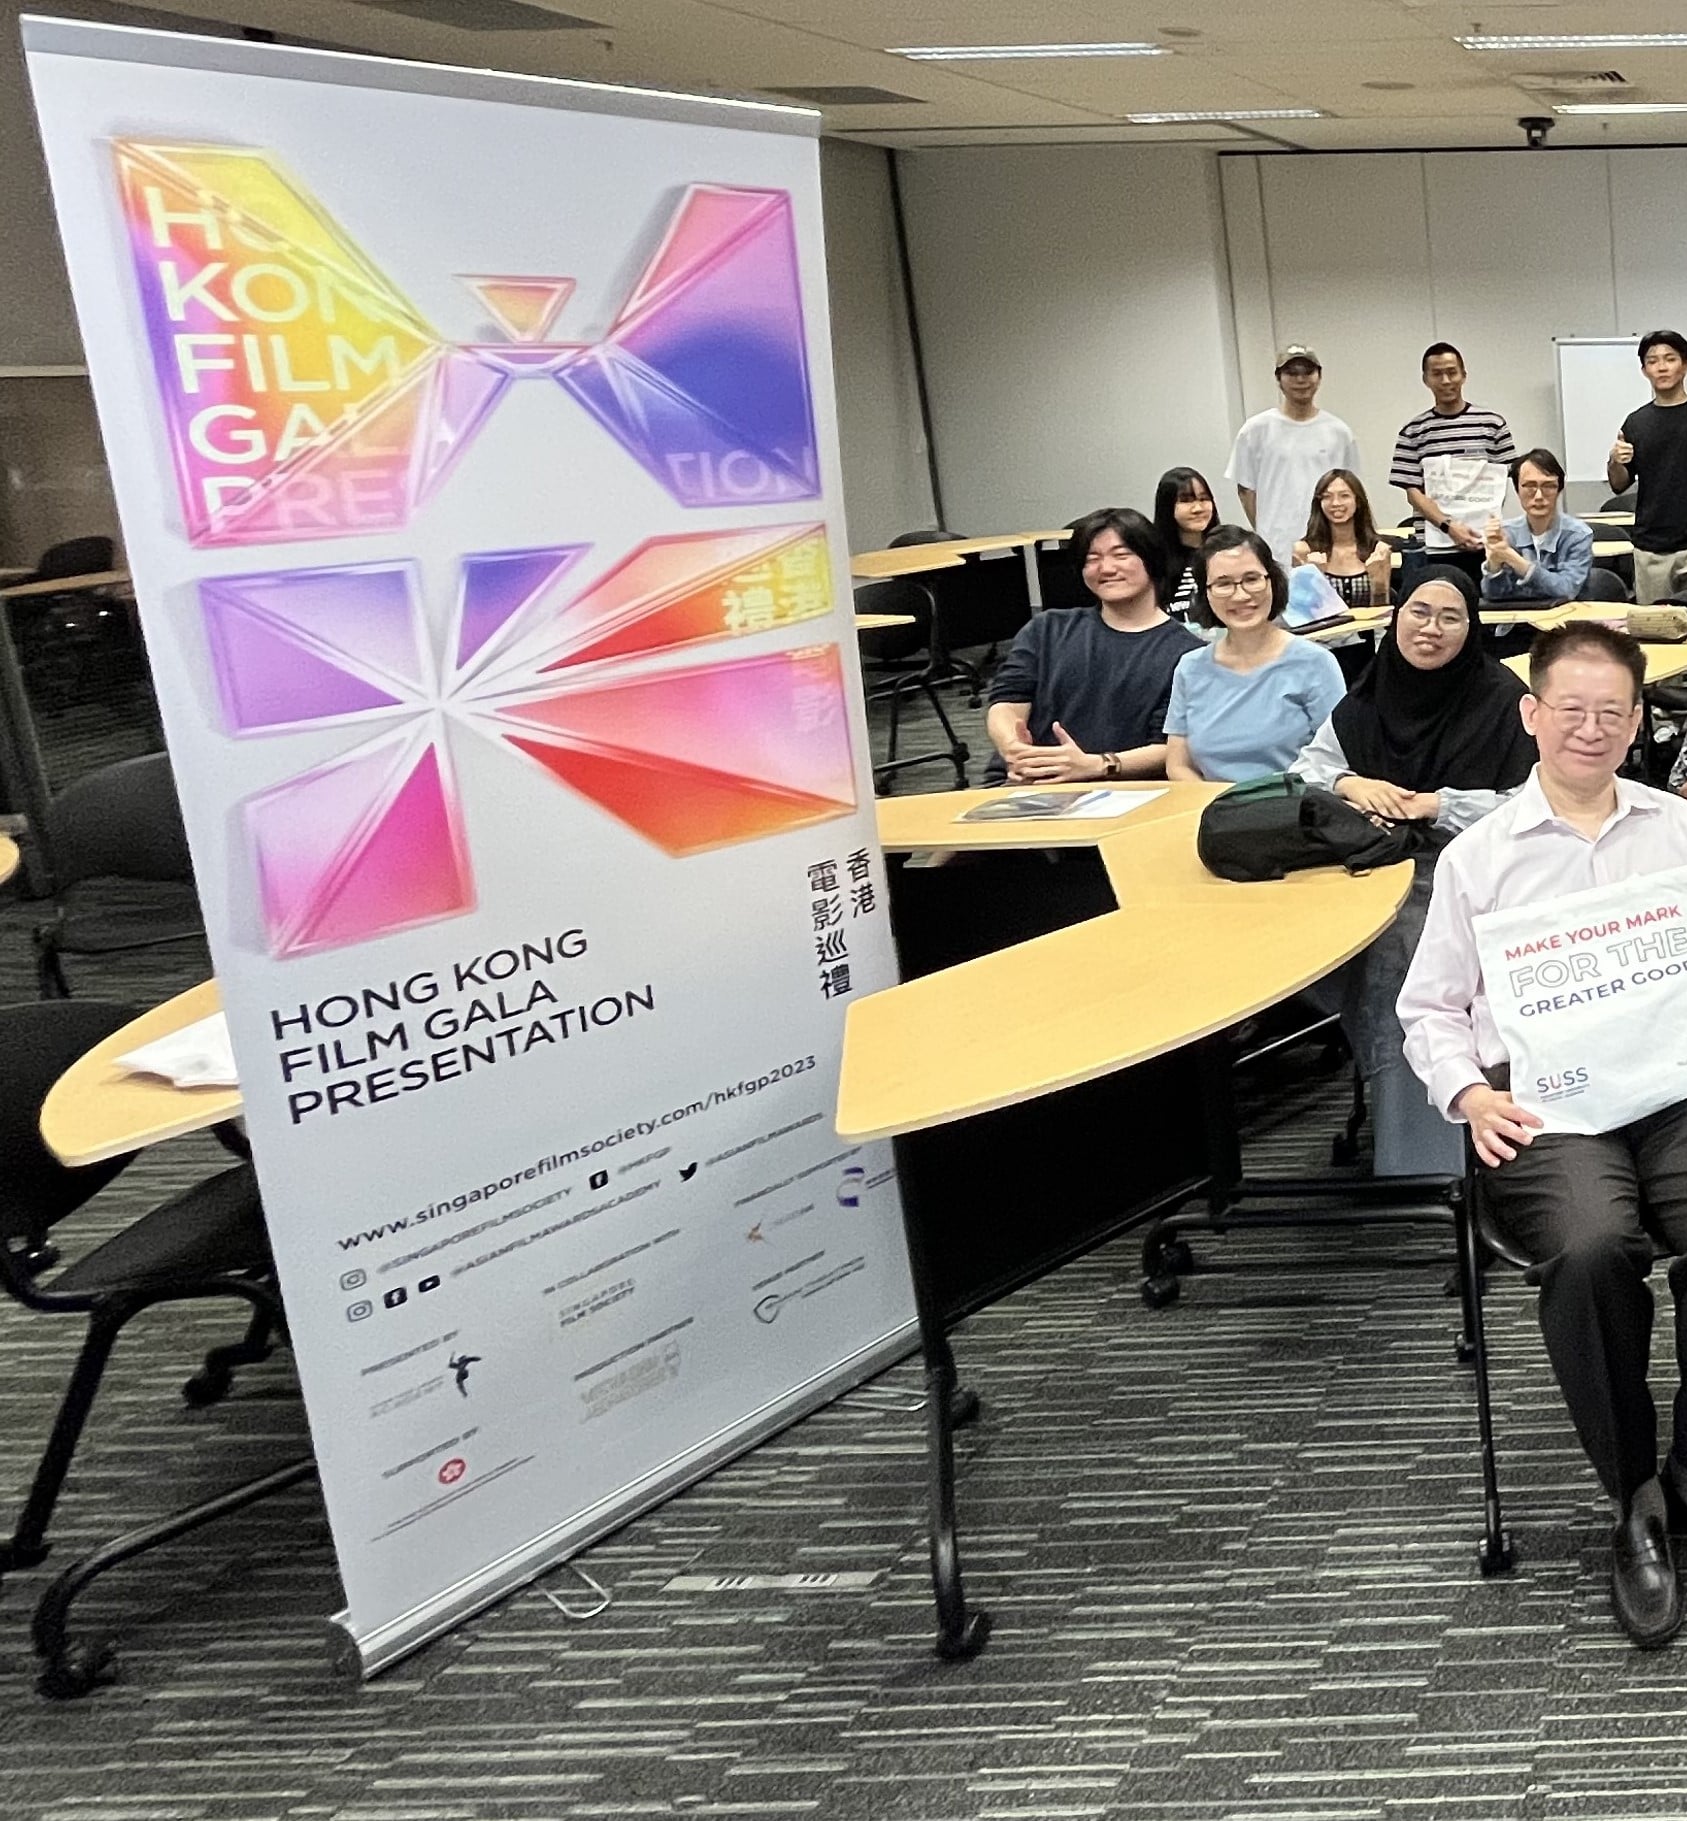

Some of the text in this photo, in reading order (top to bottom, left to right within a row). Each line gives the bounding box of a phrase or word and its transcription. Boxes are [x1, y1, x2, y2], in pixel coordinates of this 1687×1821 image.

[173, 333, 403, 394] FILM
[846, 847, 876, 919] 香港
[807, 858, 853, 1000] 電影巡禮
[1505, 903, 1683, 961] MAKE YOUR MARK
[270, 928, 589, 1041] HONG KONG
[1509, 952, 1602, 998] FOR
[1519, 978, 1627, 1018] GREATER
[279, 979, 559, 1083] FILM GALA
[288, 984, 657, 1125] PRESENTATION
[1536, 1066, 1589, 1093] SUSS
[338, 1055, 817, 1251] www.singaporefilmsociety.com/hkfgp2023
